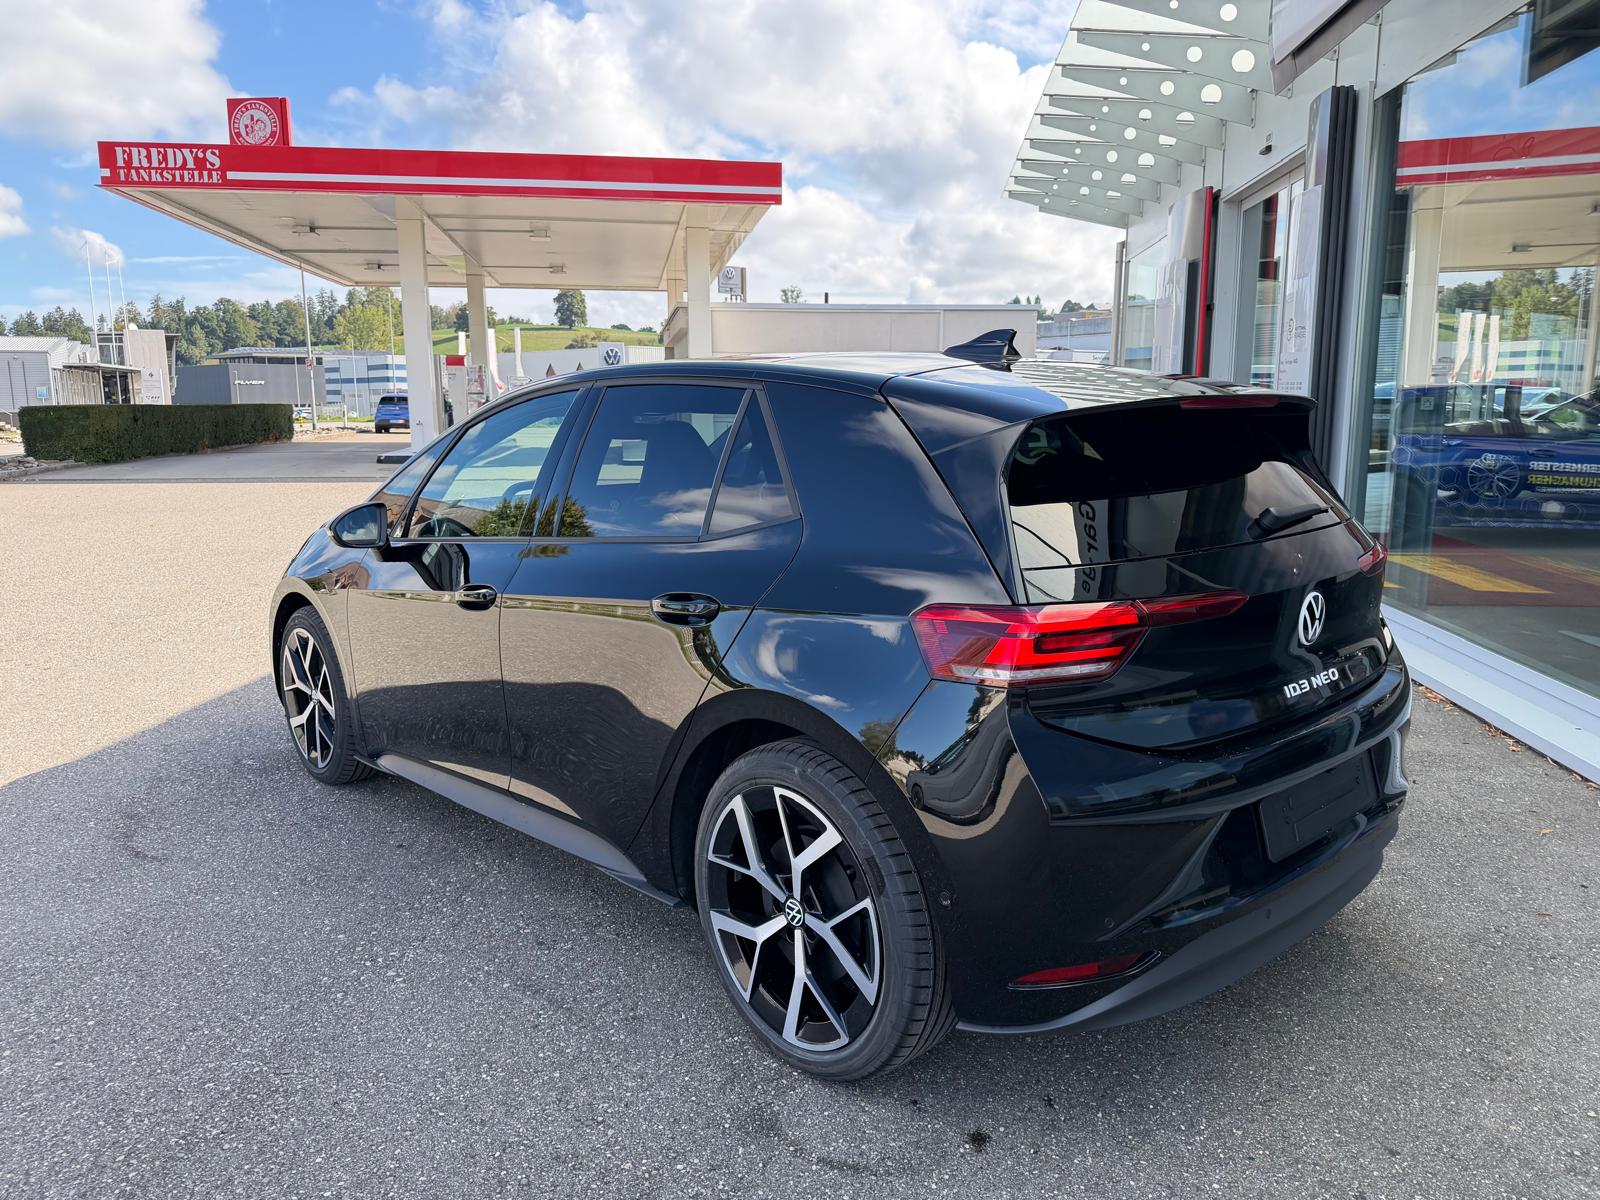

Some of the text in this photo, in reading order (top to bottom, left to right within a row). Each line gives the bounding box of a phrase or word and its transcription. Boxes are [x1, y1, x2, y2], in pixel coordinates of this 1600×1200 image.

[246, 103, 278, 132] TANKSTELLE
[114, 146, 221, 169] FREDY'S
[117, 168, 222, 184] TANKSTELLE
[1310, 668, 1339, 688] NEO
